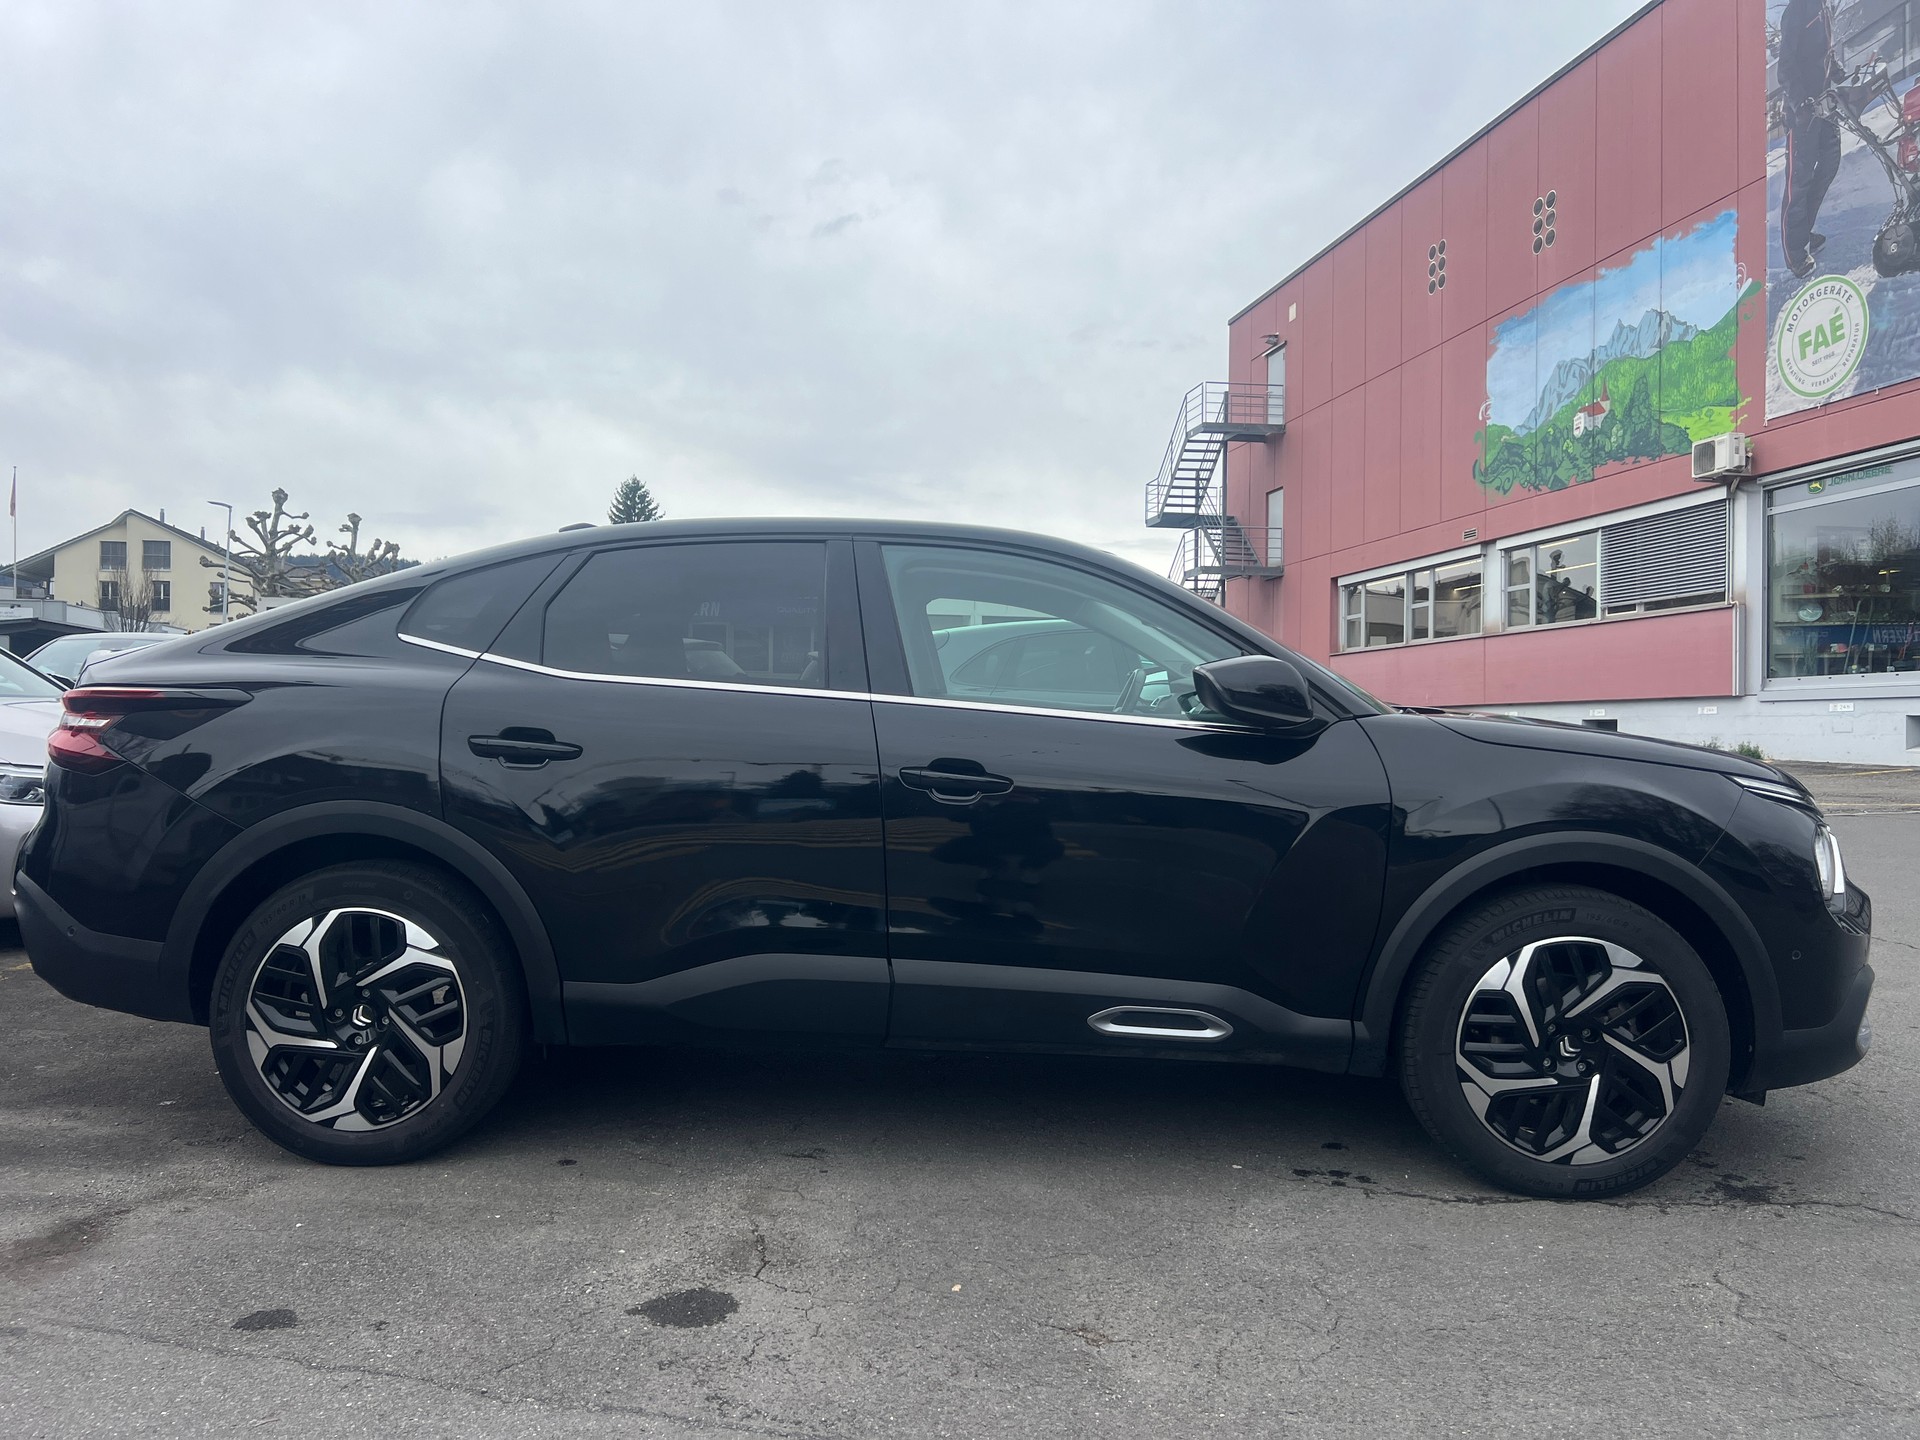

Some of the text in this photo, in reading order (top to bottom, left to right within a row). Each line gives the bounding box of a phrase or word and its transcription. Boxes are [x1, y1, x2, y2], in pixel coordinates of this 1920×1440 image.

[1787, 285, 1853, 333] MOTORGERÄTE
[1798, 305, 1846, 361] FAÉ
[1785, 322, 1860, 388] BERATUNG VERKAUF REPARATUR
[1828, 465, 1894, 487] JOHN DEERE
[1491, 910, 1572, 943] MICHELIN
